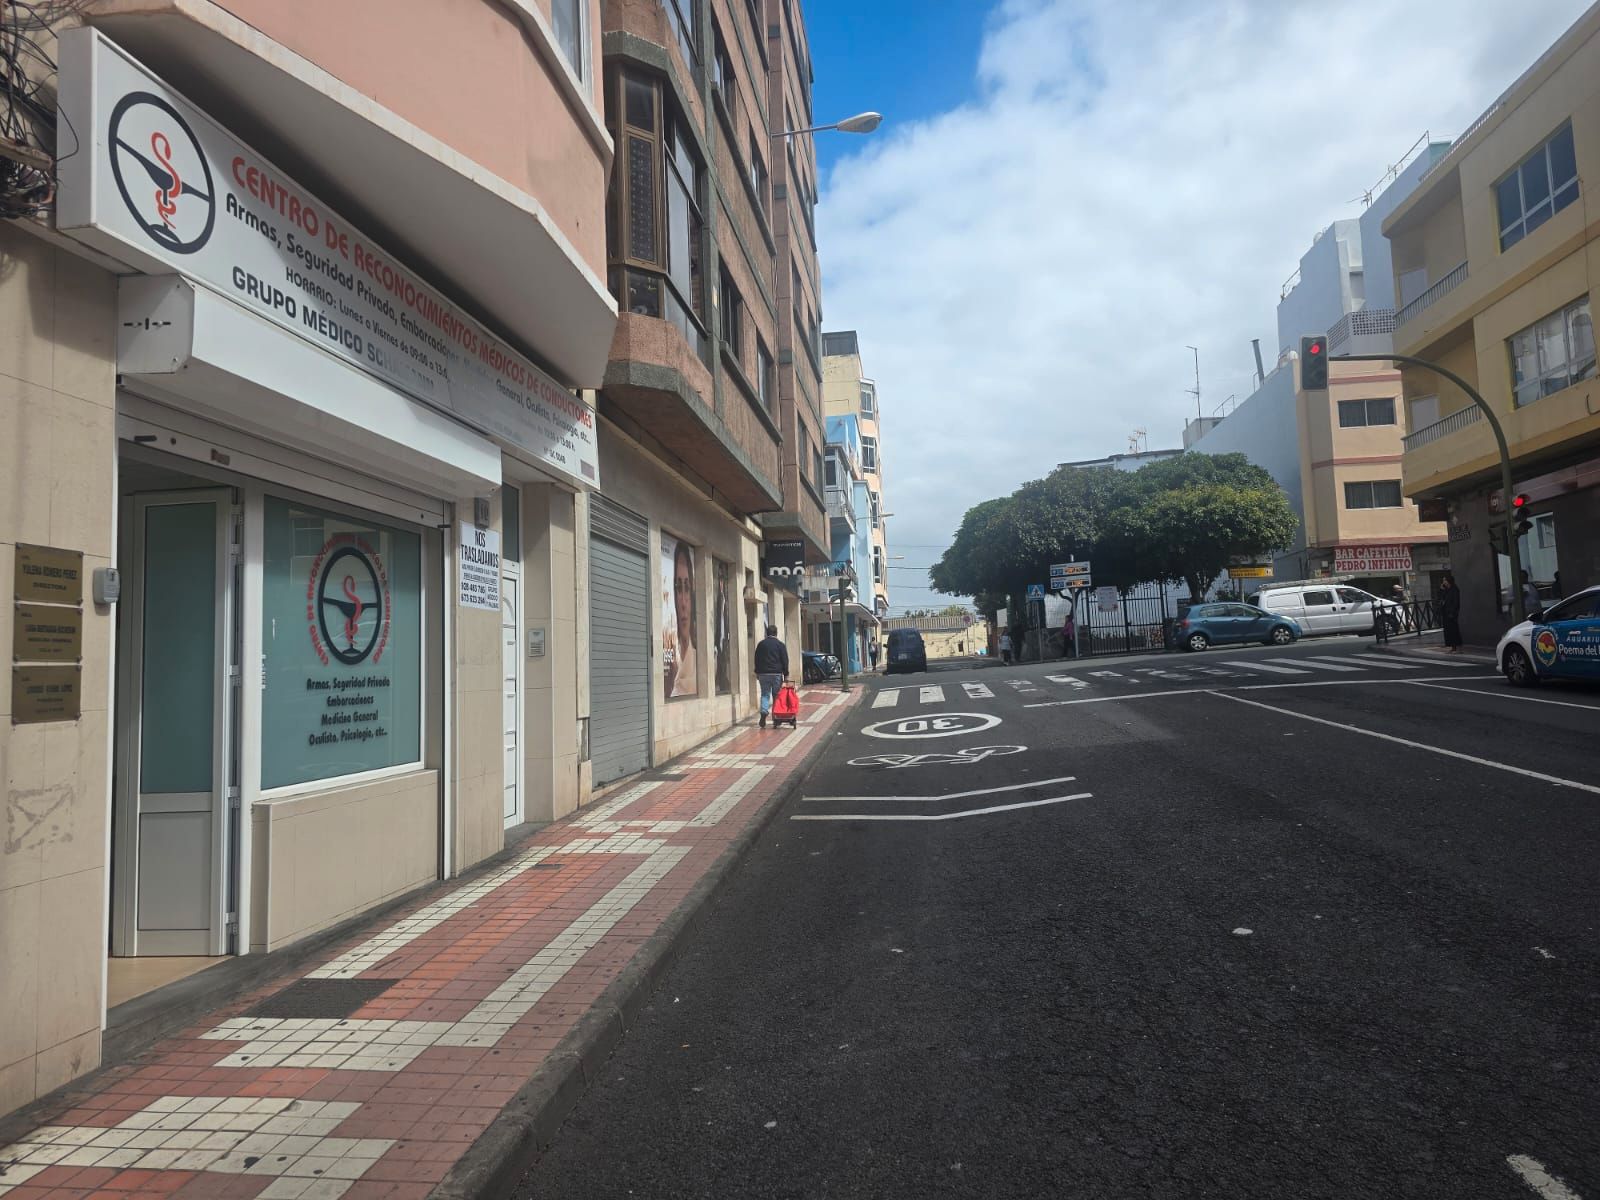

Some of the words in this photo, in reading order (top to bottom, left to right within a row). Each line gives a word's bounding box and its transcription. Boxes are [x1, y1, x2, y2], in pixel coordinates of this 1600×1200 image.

[226, 193, 281, 249] Armas,
[286, 233, 353, 290] Seguridad
[357, 279, 398, 326] Privada,
[231, 156, 319, 237] CENTRO
[325, 221, 349, 260] DE
[354, 243, 478, 354] RECONOCIMIENTOS
[480, 342, 525, 385] MÉDICOS
[527, 371, 539, 394] DE
[540, 384, 592, 429] CONDUCTORES
[232, 265, 297, 319] GRUPO
[302, 309, 363, 355] MÉDICO
[286, 266, 337, 309] HORARIO:
[339, 298, 363, 325] Lunes
[365, 319, 371, 330] a
[372, 319, 399, 348] Viernes
[475, 530, 486, 548] NOS
[1334, 549, 1355, 560] BAR
[1335, 560, 1367, 571] PEDRO
[1368, 559, 1411, 570] INFINITO
[1567, 635, 1600, 643] AQUARIU
[1558, 643, 1585, 656] Poema
[306, 678, 332, 691] Armas,
[333, 675, 366, 692] Seguridad
[367, 674, 390, 688] Privada
[326, 692, 375, 707] Embarcaciones
[321, 711, 352, 726] Medicina
[353, 708, 379, 722] General
[897, 717, 965, 733] 30
